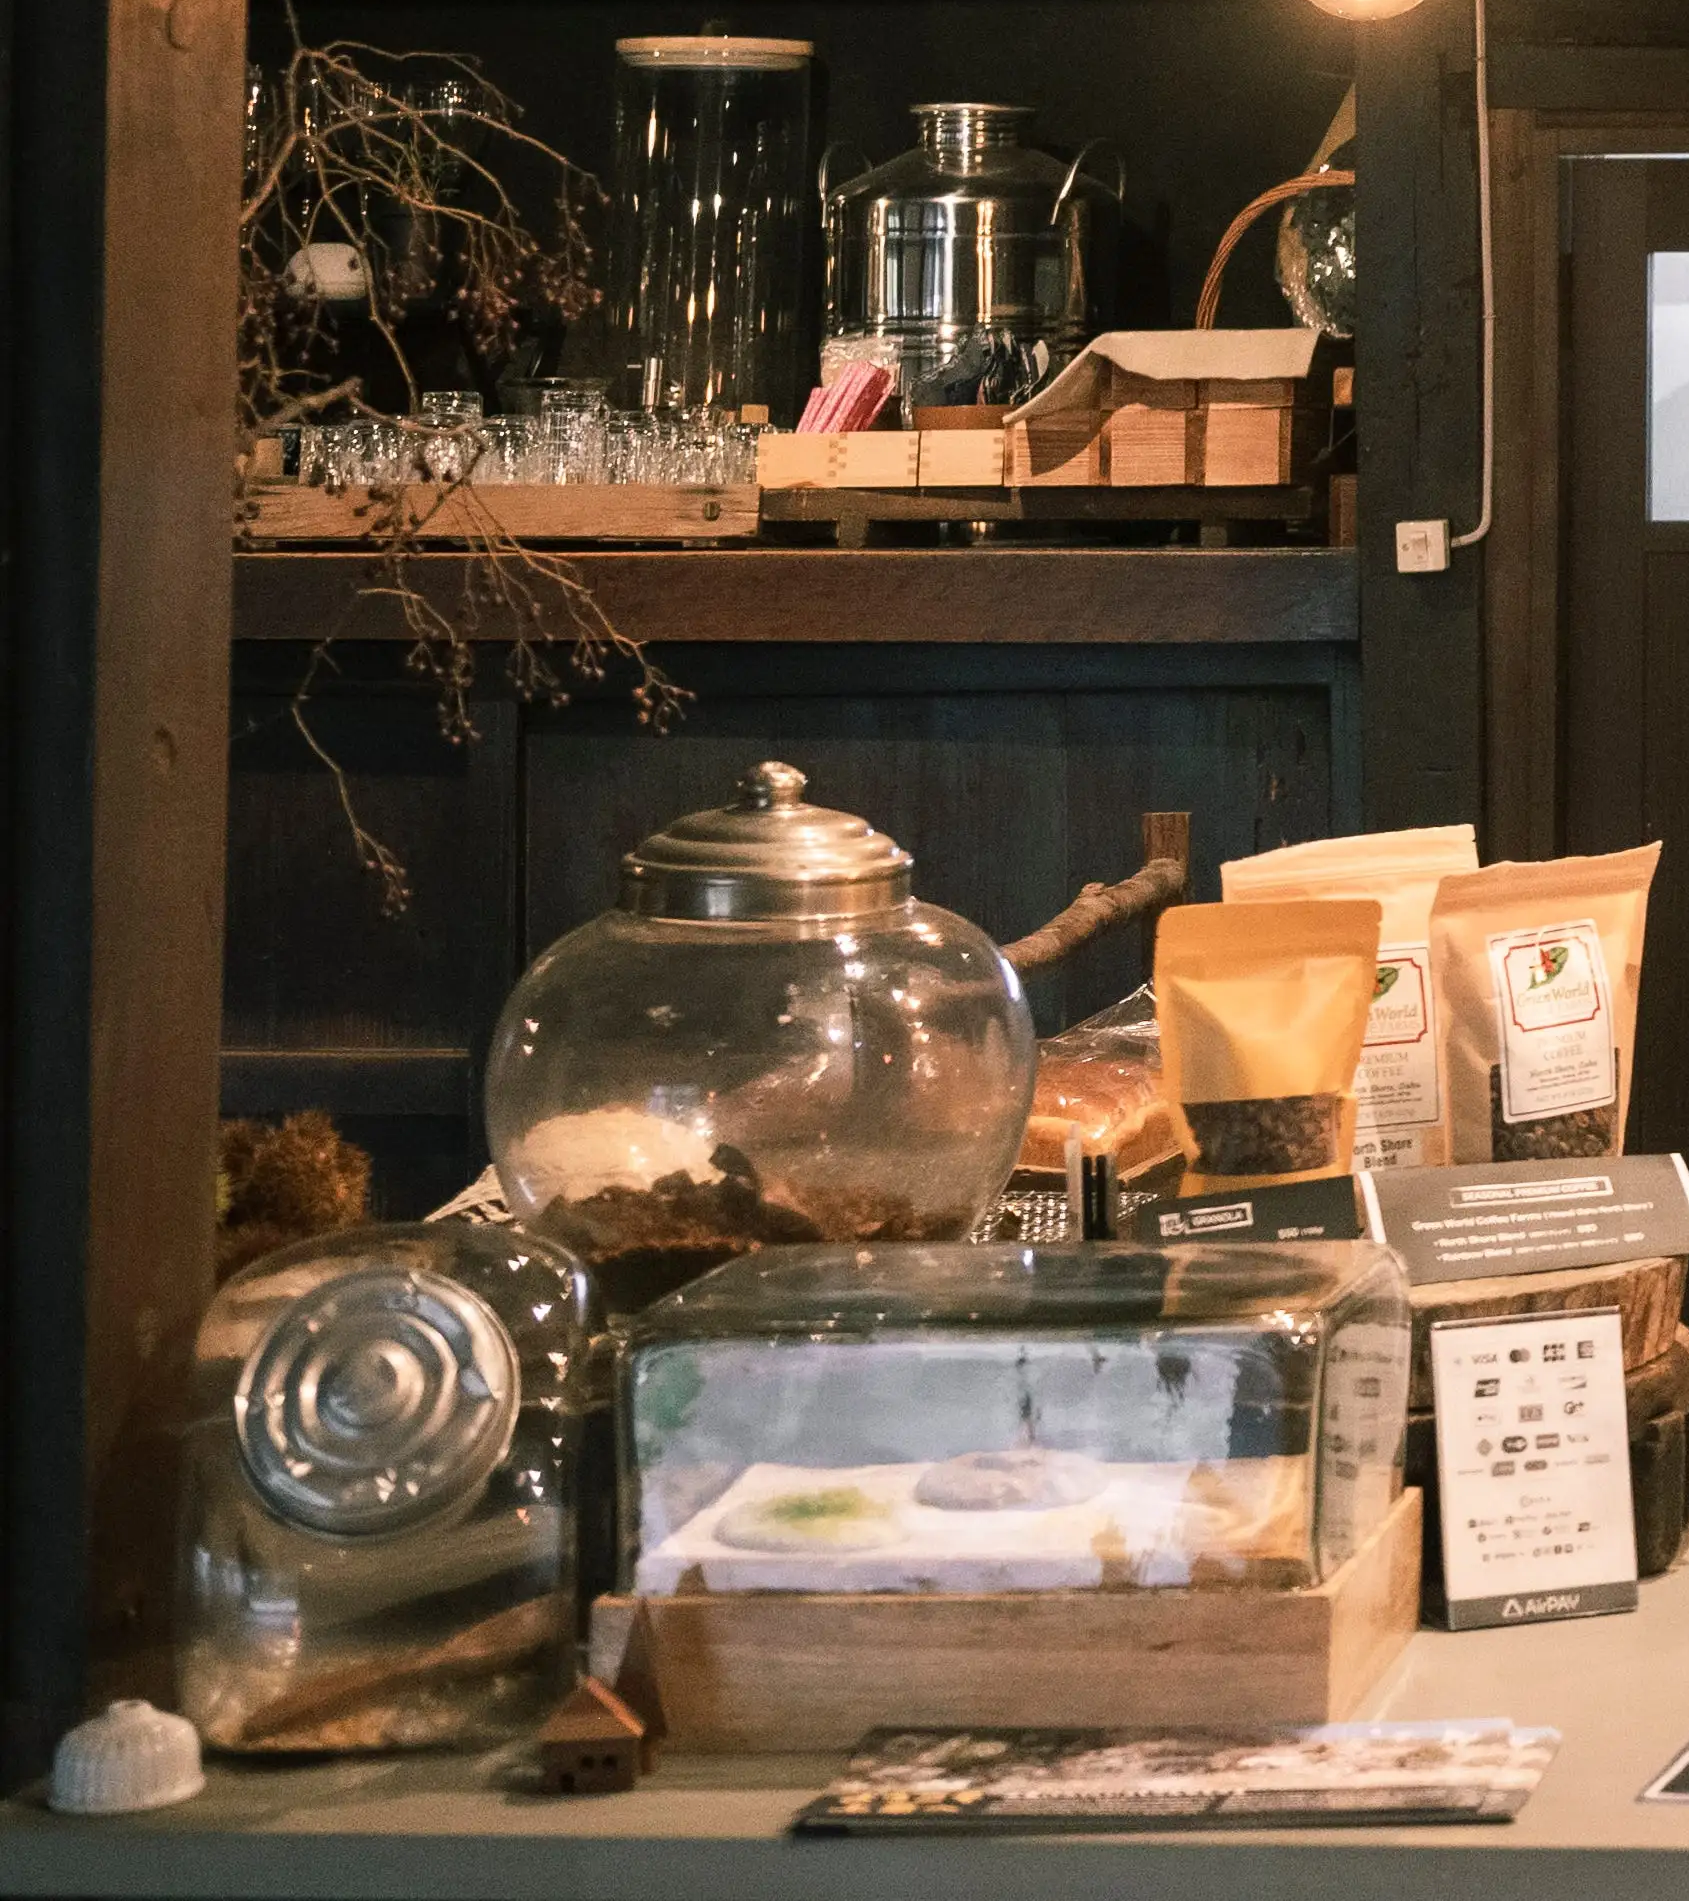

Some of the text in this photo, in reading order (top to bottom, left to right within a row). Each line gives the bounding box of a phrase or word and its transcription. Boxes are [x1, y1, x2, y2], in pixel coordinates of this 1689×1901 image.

[1552, 980, 1590, 1000] World
[1374, 1006, 1418, 1021] World
[1360, 1052, 1408, 1065] REMIUM
[1353, 1138, 1413, 1156] orth Shore
[1363, 1154, 1398, 1169] Blend
